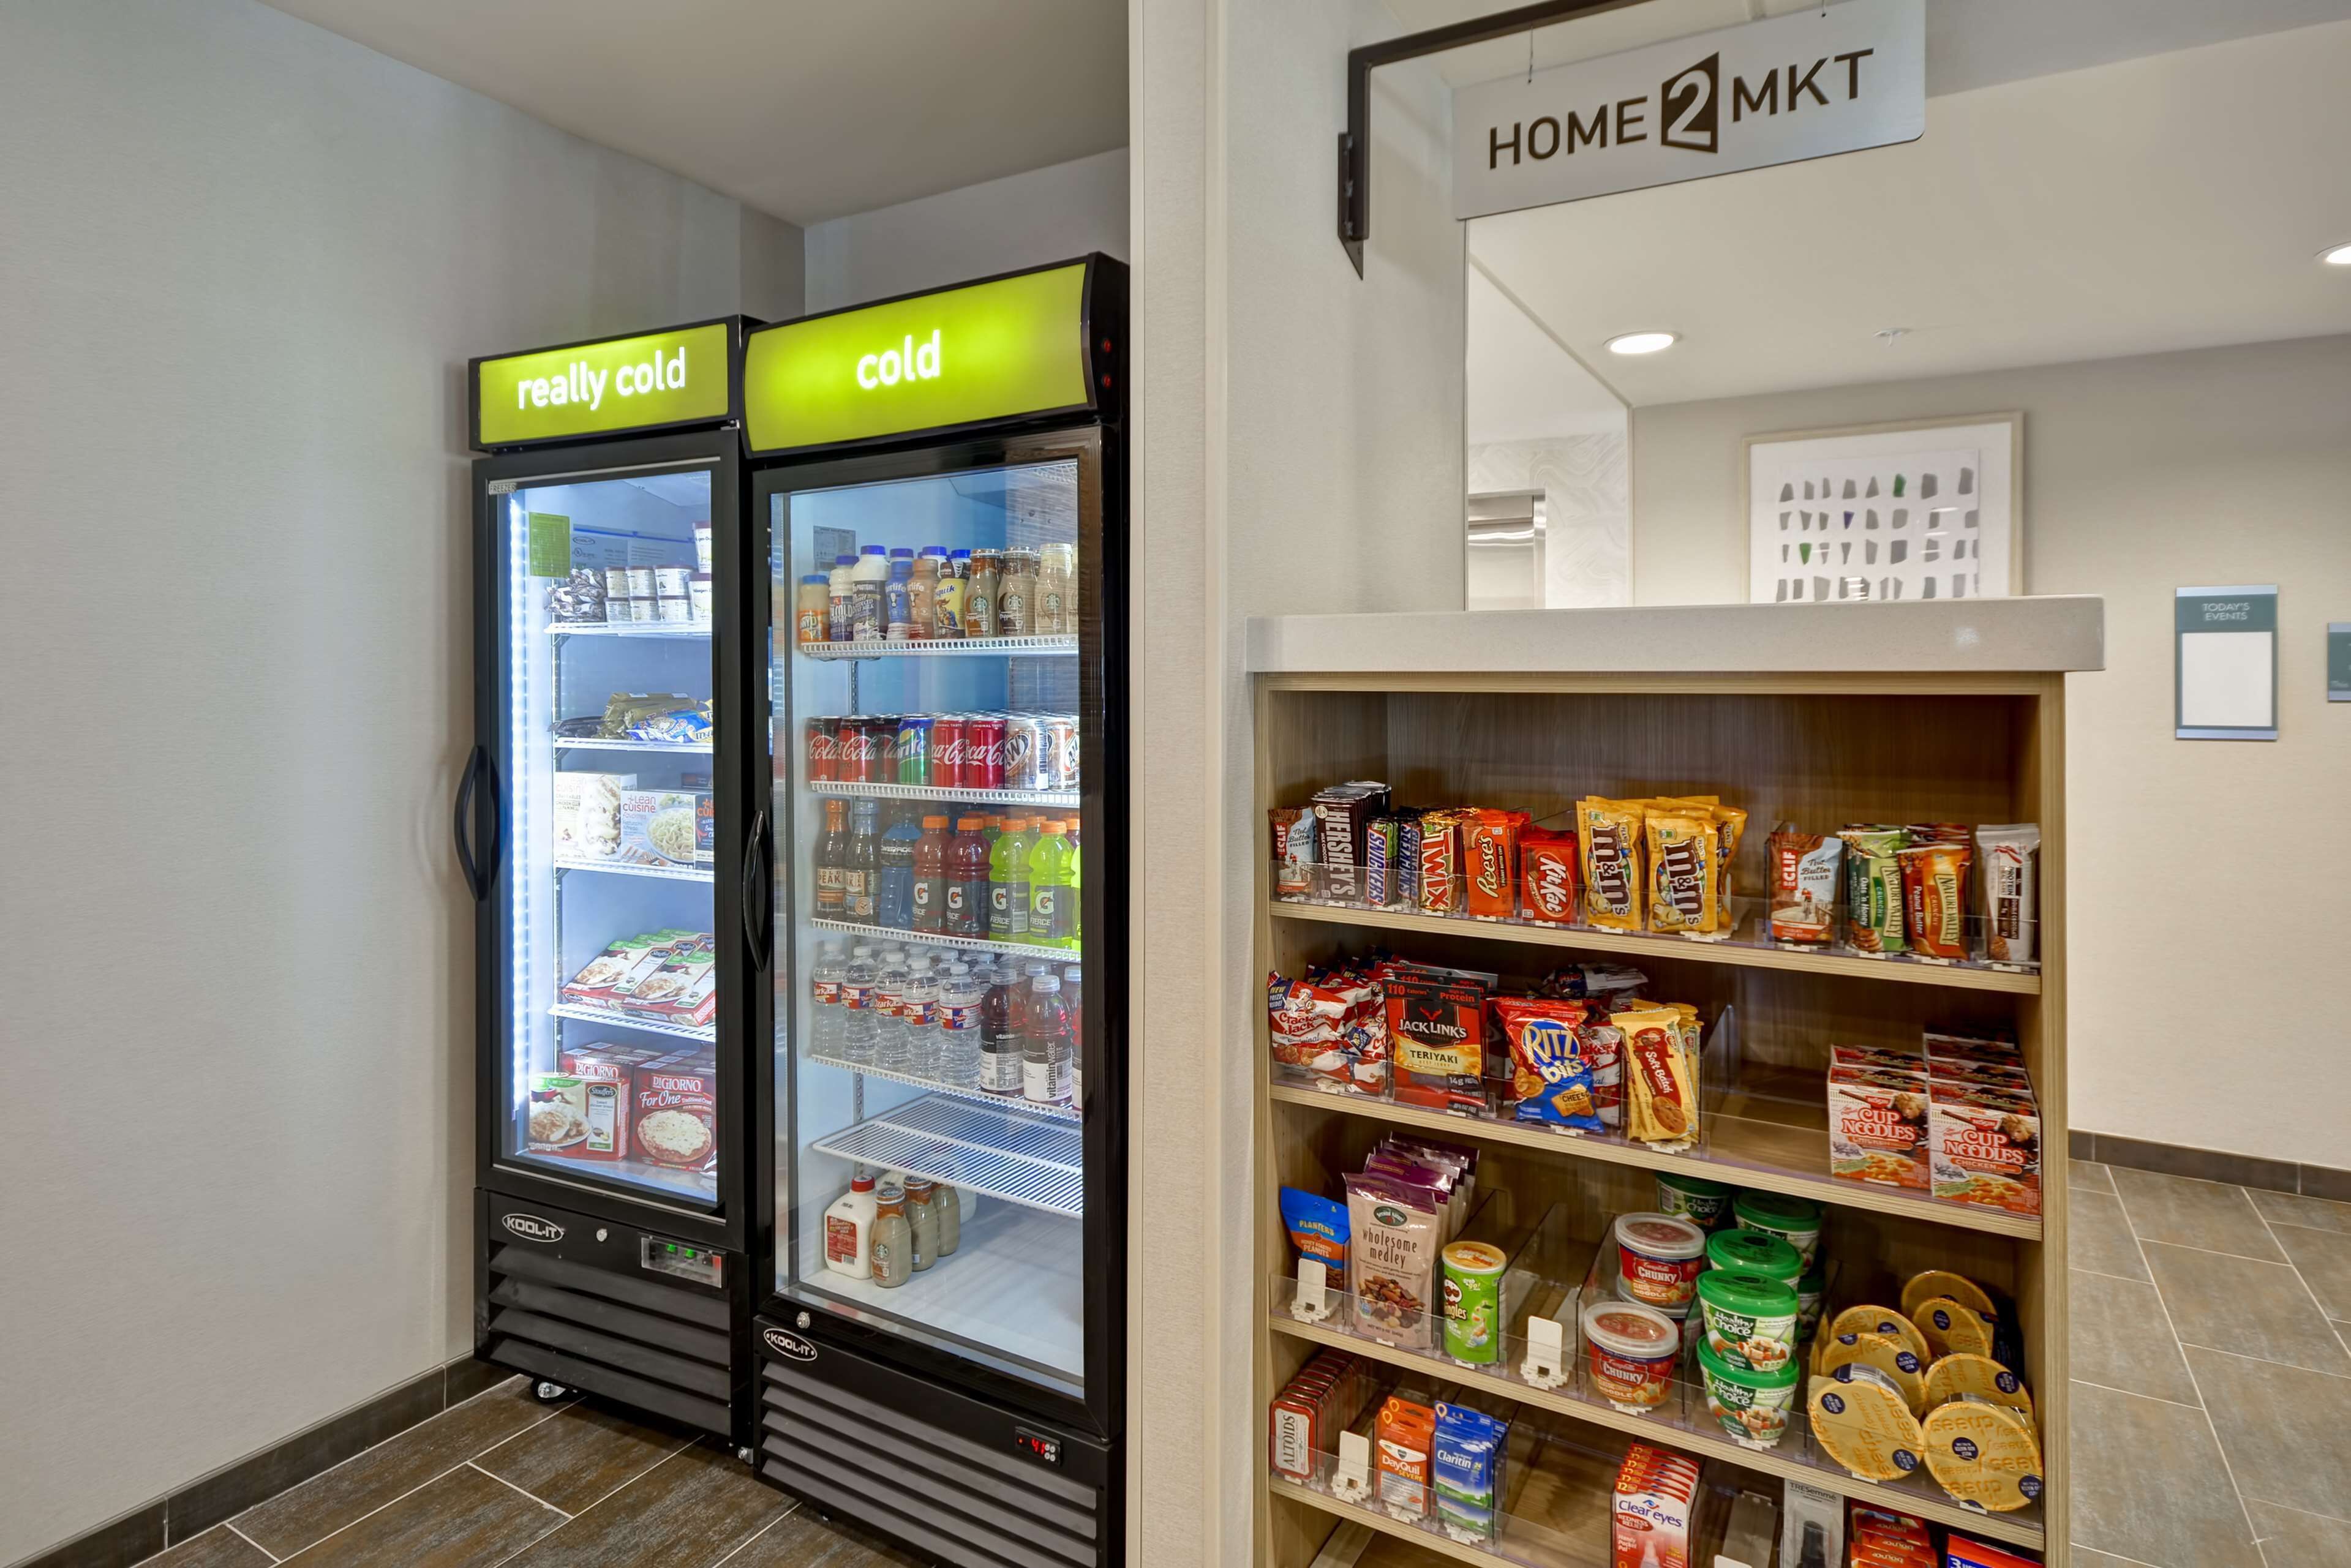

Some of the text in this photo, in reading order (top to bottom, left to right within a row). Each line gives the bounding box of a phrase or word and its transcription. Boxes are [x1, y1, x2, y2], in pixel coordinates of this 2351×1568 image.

[1489, 48, 1874, 170] HOME 2 MKT
[856, 329, 941, 388] cold
[517, 347, 685, 411] really cold
[2202, 602, 2251, 612] TODAY'S
[2205, 612, 2248, 621] EVENTS
[623, 803, 656, 812] cuisine
[1277, 825, 1286, 848] CLIF
[1288, 834, 1310, 843] Butter
[1325, 811, 1355, 896] HERSHEY'S
[1398, 824, 1411, 895] SNICKERS
[1369, 831, 1385, 904] SNICKERS
[1422, 830, 1451, 908] TWIX
[1476, 835, 1499, 898] Reese's
[1783, 851, 1797, 880] CLIF
[1800, 866, 1831, 875] Butter
[819, 875, 841, 883] PEAK
[1860, 877, 1869, 894] Oats
[914, 883, 928, 904] G
[948, 887, 963, 909] G
[991, 888, 1007, 910] G
[1036, 891, 1054, 914] G
[1884, 868, 1902, 935] NATURE VALLEY
[1913, 886, 1924, 934] Peanut Butter
[1939, 877, 1960, 944] NATURE VALLEY
[990, 916, 1010, 925] FIERCE
[1030, 917, 1051, 926] FIERCE
[1387, 984, 1405, 996] 110
[1440, 992, 1475, 1003] Protein
[1284, 1022, 1315, 1035] Jack
[1398, 1019, 1468, 1039] JACK LINK'S
[1524, 1026, 1576, 1063] RITZ
[1410, 1049, 1458, 1064] TERIYAKI
[1047, 1041, 1057, 1098] vitaminwater
[1540, 1059, 1584, 1084] bits
[1646, 1051, 1661, 1070] Soft
[1655, 1069, 1674, 1093] Batch
[1449, 1077, 1464, 1086] 14g
[639, 1092, 656, 1107] For
[659, 1090, 680, 1107] One
[1859, 1108, 1900, 1125] CUP
[1842, 1119, 1916, 1140] NOODLES
[1962, 1130, 2008, 1147] CUP
[1944, 1141, 2025, 1164] NOODLES
[1955, 1159, 1997, 1169] CHICKEN
[1299, 1220, 1335, 1237] PLANTERS
[1362, 1228, 1418, 1253] wholesome
[1303, 1245, 1330, 1257] PEANUTS
[1369, 1247, 1407, 1269] medley
[1638, 1265, 1677, 1283] CHUNKY
[1634, 1288, 1668, 1297] NOODLE
[1713, 1317, 1751, 1337] Choice
[1715, 1310, 1754, 1329] Healthy
[1603, 1361, 1644, 1384] CHUNKY
[1599, 1386, 1633, 1397] NOODLE
[1713, 1384, 1750, 1406] Choice
[1715, 1379, 1753, 1398] Healthy
[1283, 1414, 1295, 1468] ALTOIDS
[1382, 1455, 1420, 1476] DayQuil
[1437, 1449, 1472, 1469] Claritin
[1399, 1469, 1424, 1482] SEVERE
[1617, 1482, 1628, 1491] 12
[1618, 1514, 1649, 1527] REDNESS
[1619, 1499, 1683, 1527] Clear eyes
[1622, 1520, 1644, 1530] RELIEF
[1618, 1539, 1637, 1549] Pocket
[1882, 1540, 1914, 1551] bounce
[1871, 1552, 1903, 1564] bounce
[1950, 1557, 1962, 1568] 3
